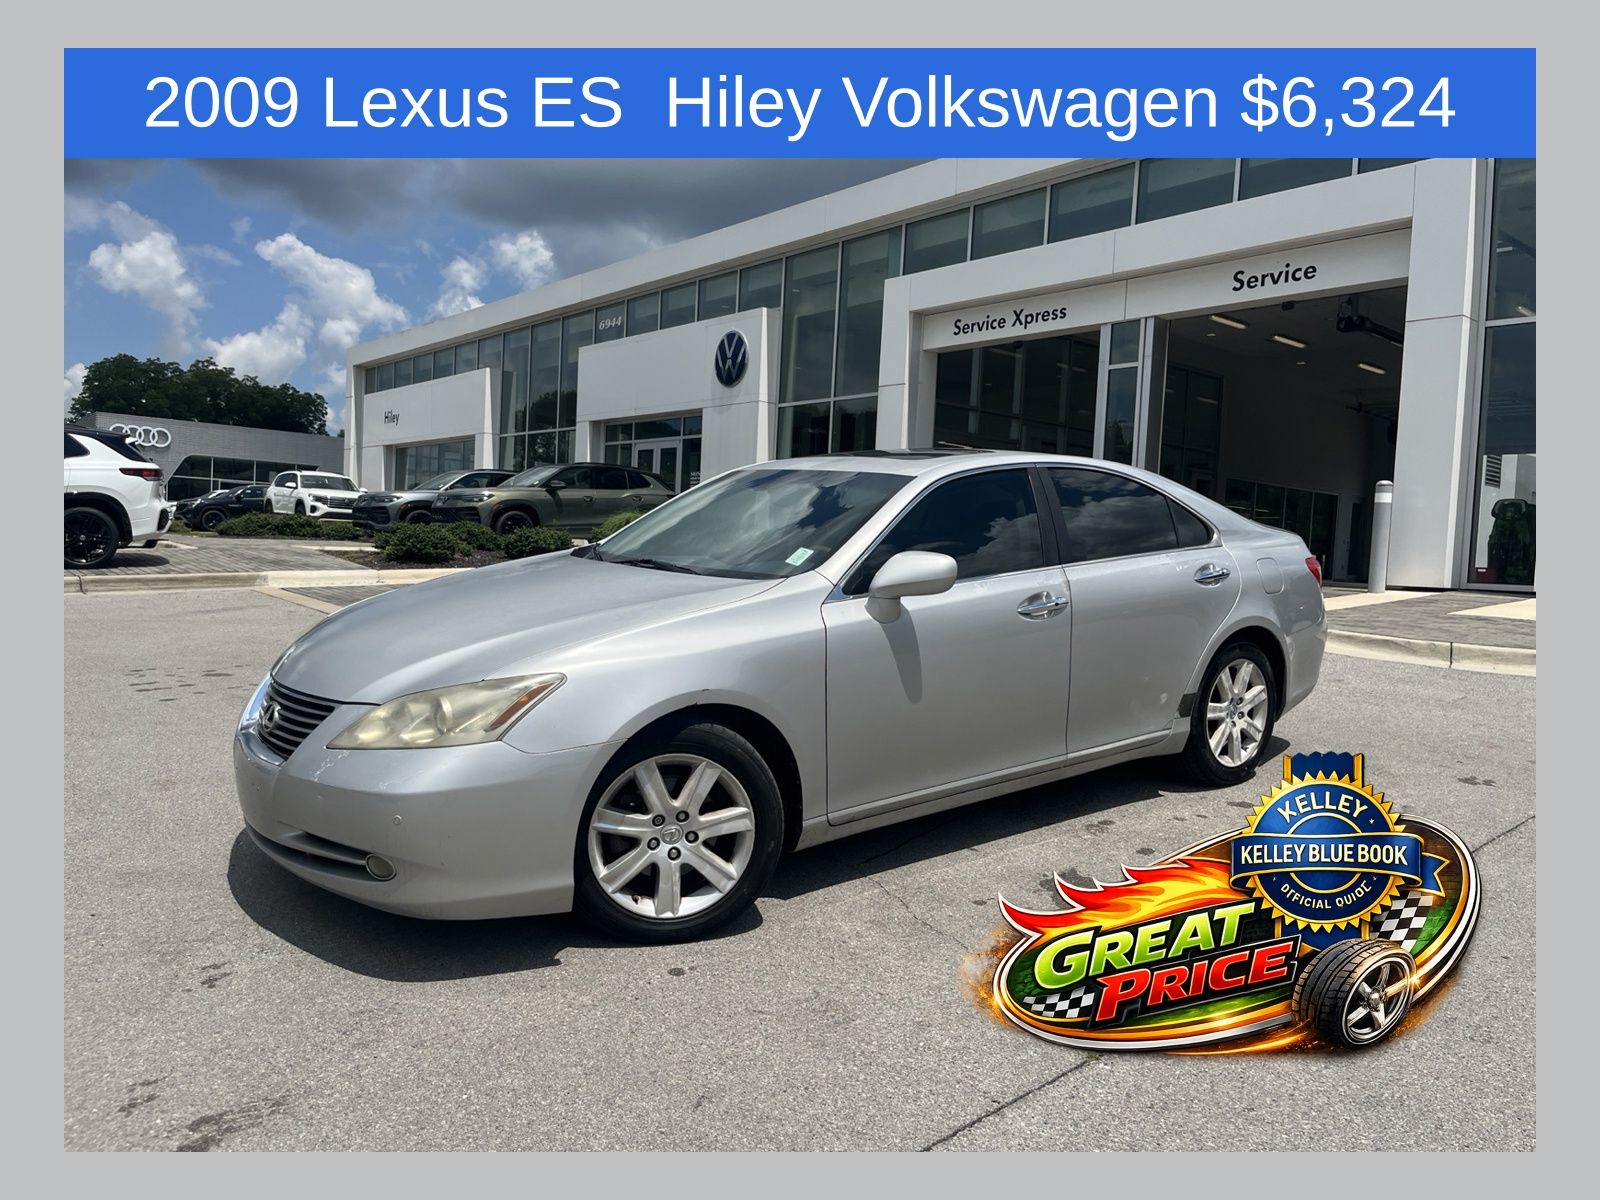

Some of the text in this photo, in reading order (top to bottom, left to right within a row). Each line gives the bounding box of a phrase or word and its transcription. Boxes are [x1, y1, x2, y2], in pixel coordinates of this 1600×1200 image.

[1232, 263, 1317, 292] Service
[599, 316, 622, 330] 6944
[953, 305, 1067, 336] Service Xpress
[384, 410, 400, 426] Hiley
